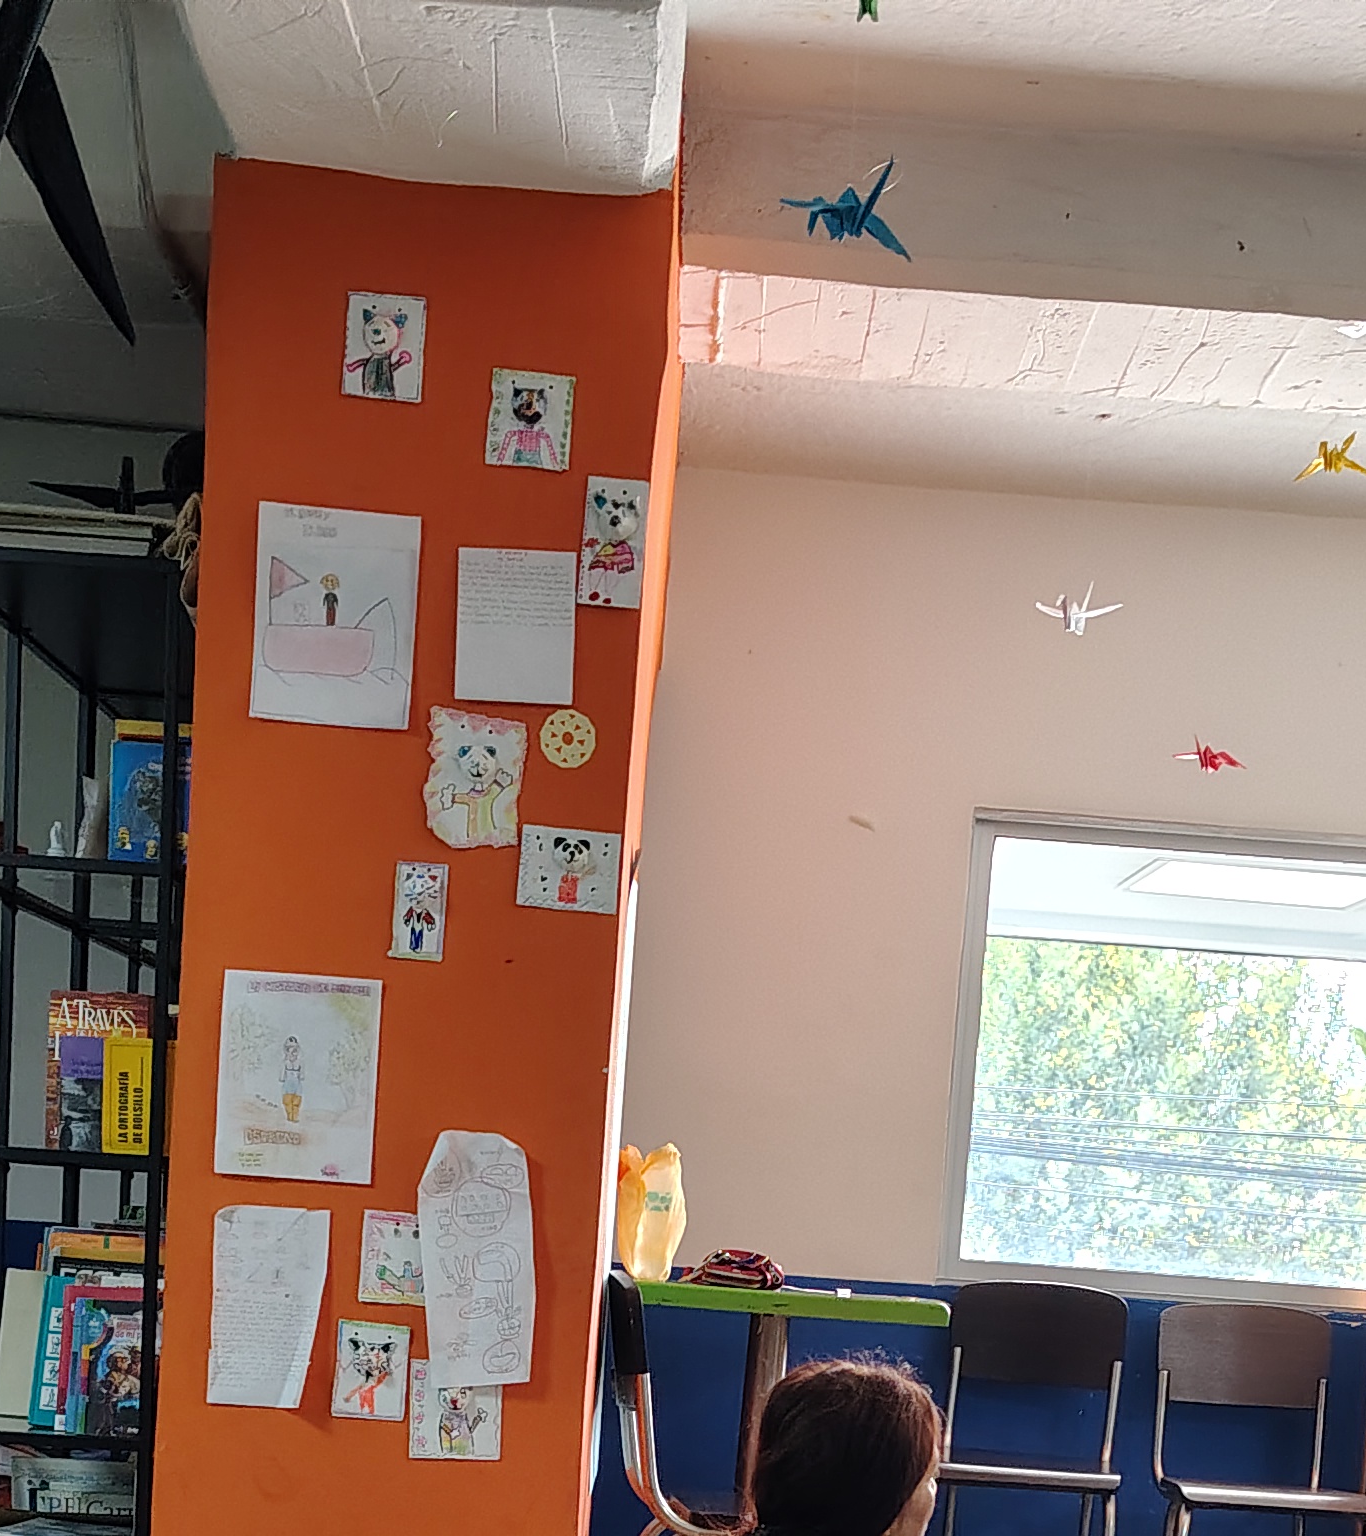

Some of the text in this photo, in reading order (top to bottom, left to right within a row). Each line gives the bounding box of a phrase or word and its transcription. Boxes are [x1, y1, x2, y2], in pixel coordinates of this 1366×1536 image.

[117, 1071, 129, 1143] LA ORTOGRAFÍA
[133, 1087, 143, 1144] DE BOLSILLO
